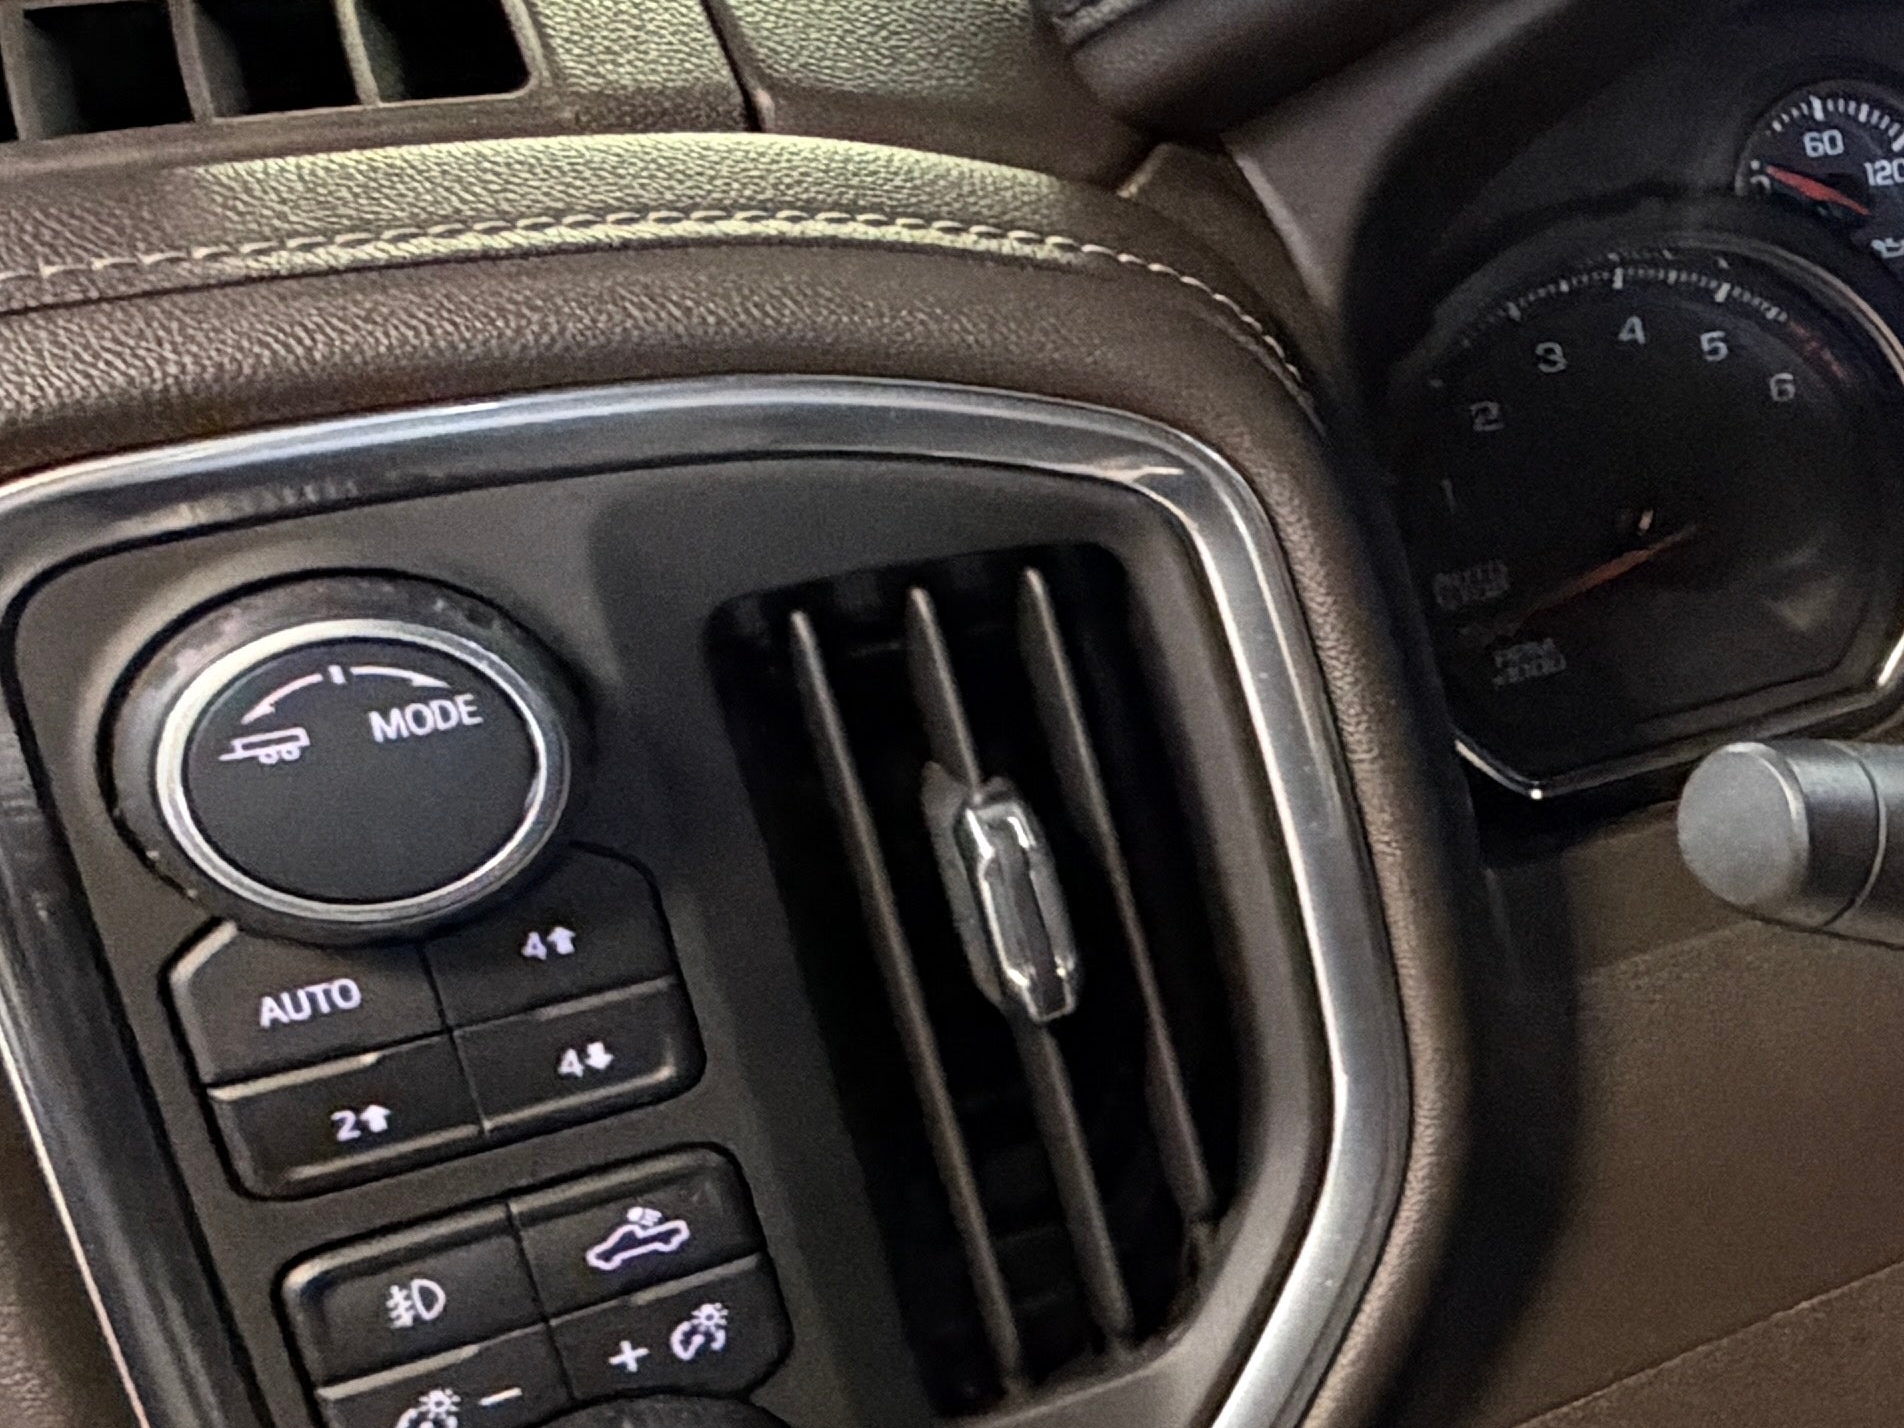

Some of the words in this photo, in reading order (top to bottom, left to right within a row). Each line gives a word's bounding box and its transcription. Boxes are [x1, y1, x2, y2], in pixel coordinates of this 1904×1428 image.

[1803, 128, 1845, 158] 60
[1617, 314, 1646, 347] 4
[1700, 331, 1730, 362] 5
[1534, 341, 1569, 373] 3
[1769, 373, 1796, 403] 6
[1469, 400, 1503, 433] 2
[369, 693, 484, 744] MODE
[258, 977, 363, 1029] AUTO
[331, 1108, 363, 1142] 2
